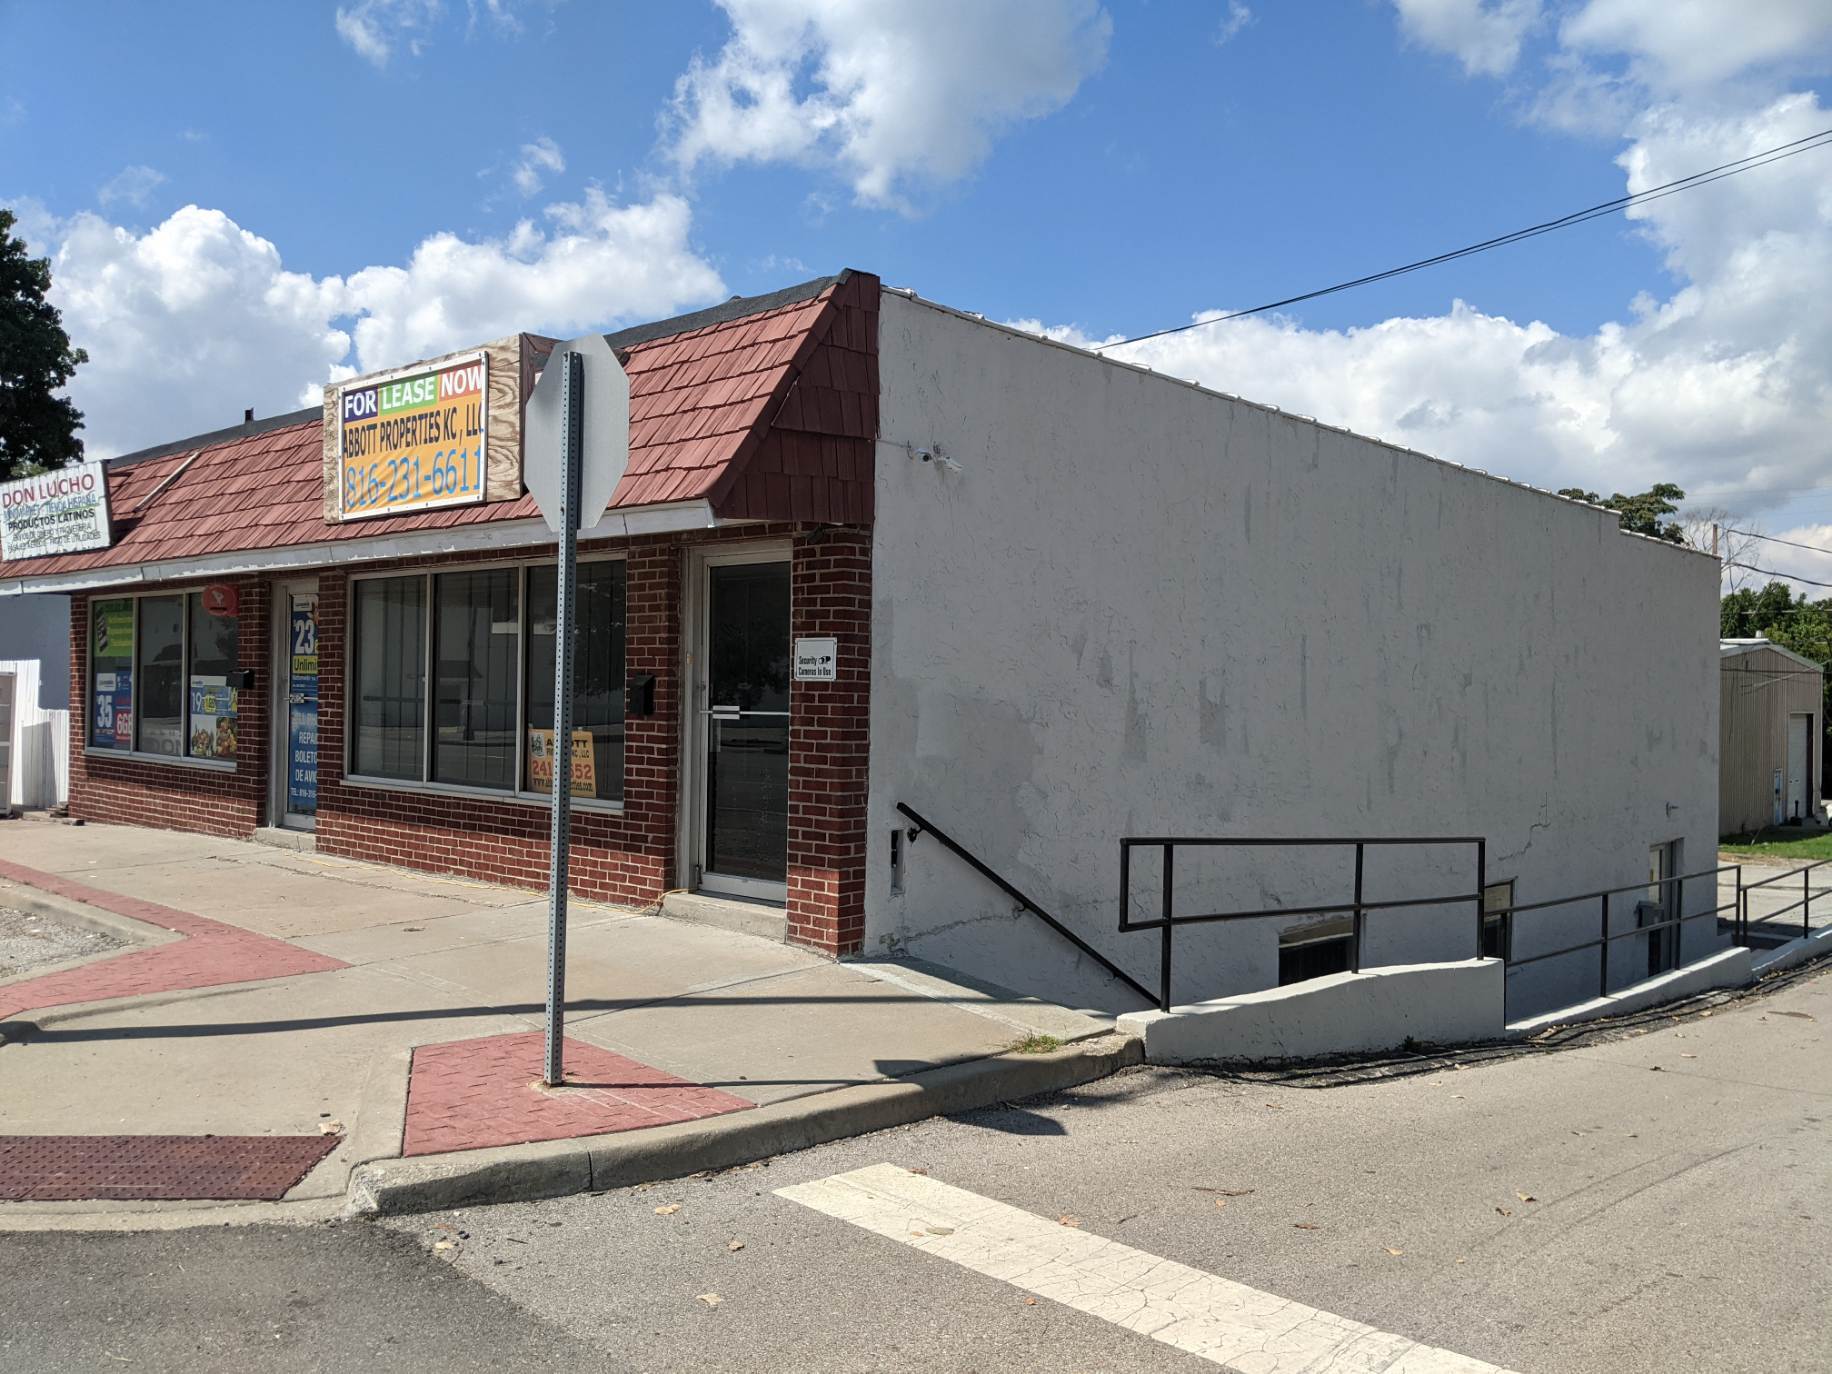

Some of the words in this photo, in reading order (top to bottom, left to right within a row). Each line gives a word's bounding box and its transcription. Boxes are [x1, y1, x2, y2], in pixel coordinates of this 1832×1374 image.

[344, 390, 377, 418] FOR
[381, 376, 435, 411] LEASE
[441, 364, 482, 397] NOW
[343, 422, 378, 459] ABBOTT
[379, 409, 441, 451] PROPERTIES
[2, 486, 34, 508] DON
[39, 473, 95, 500] LUCHO
[346, 445, 481, 508] 816-231-6611
[8, 514, 56, 532] PRODUCTOS
[57, 508, 96, 523] LATINOS
